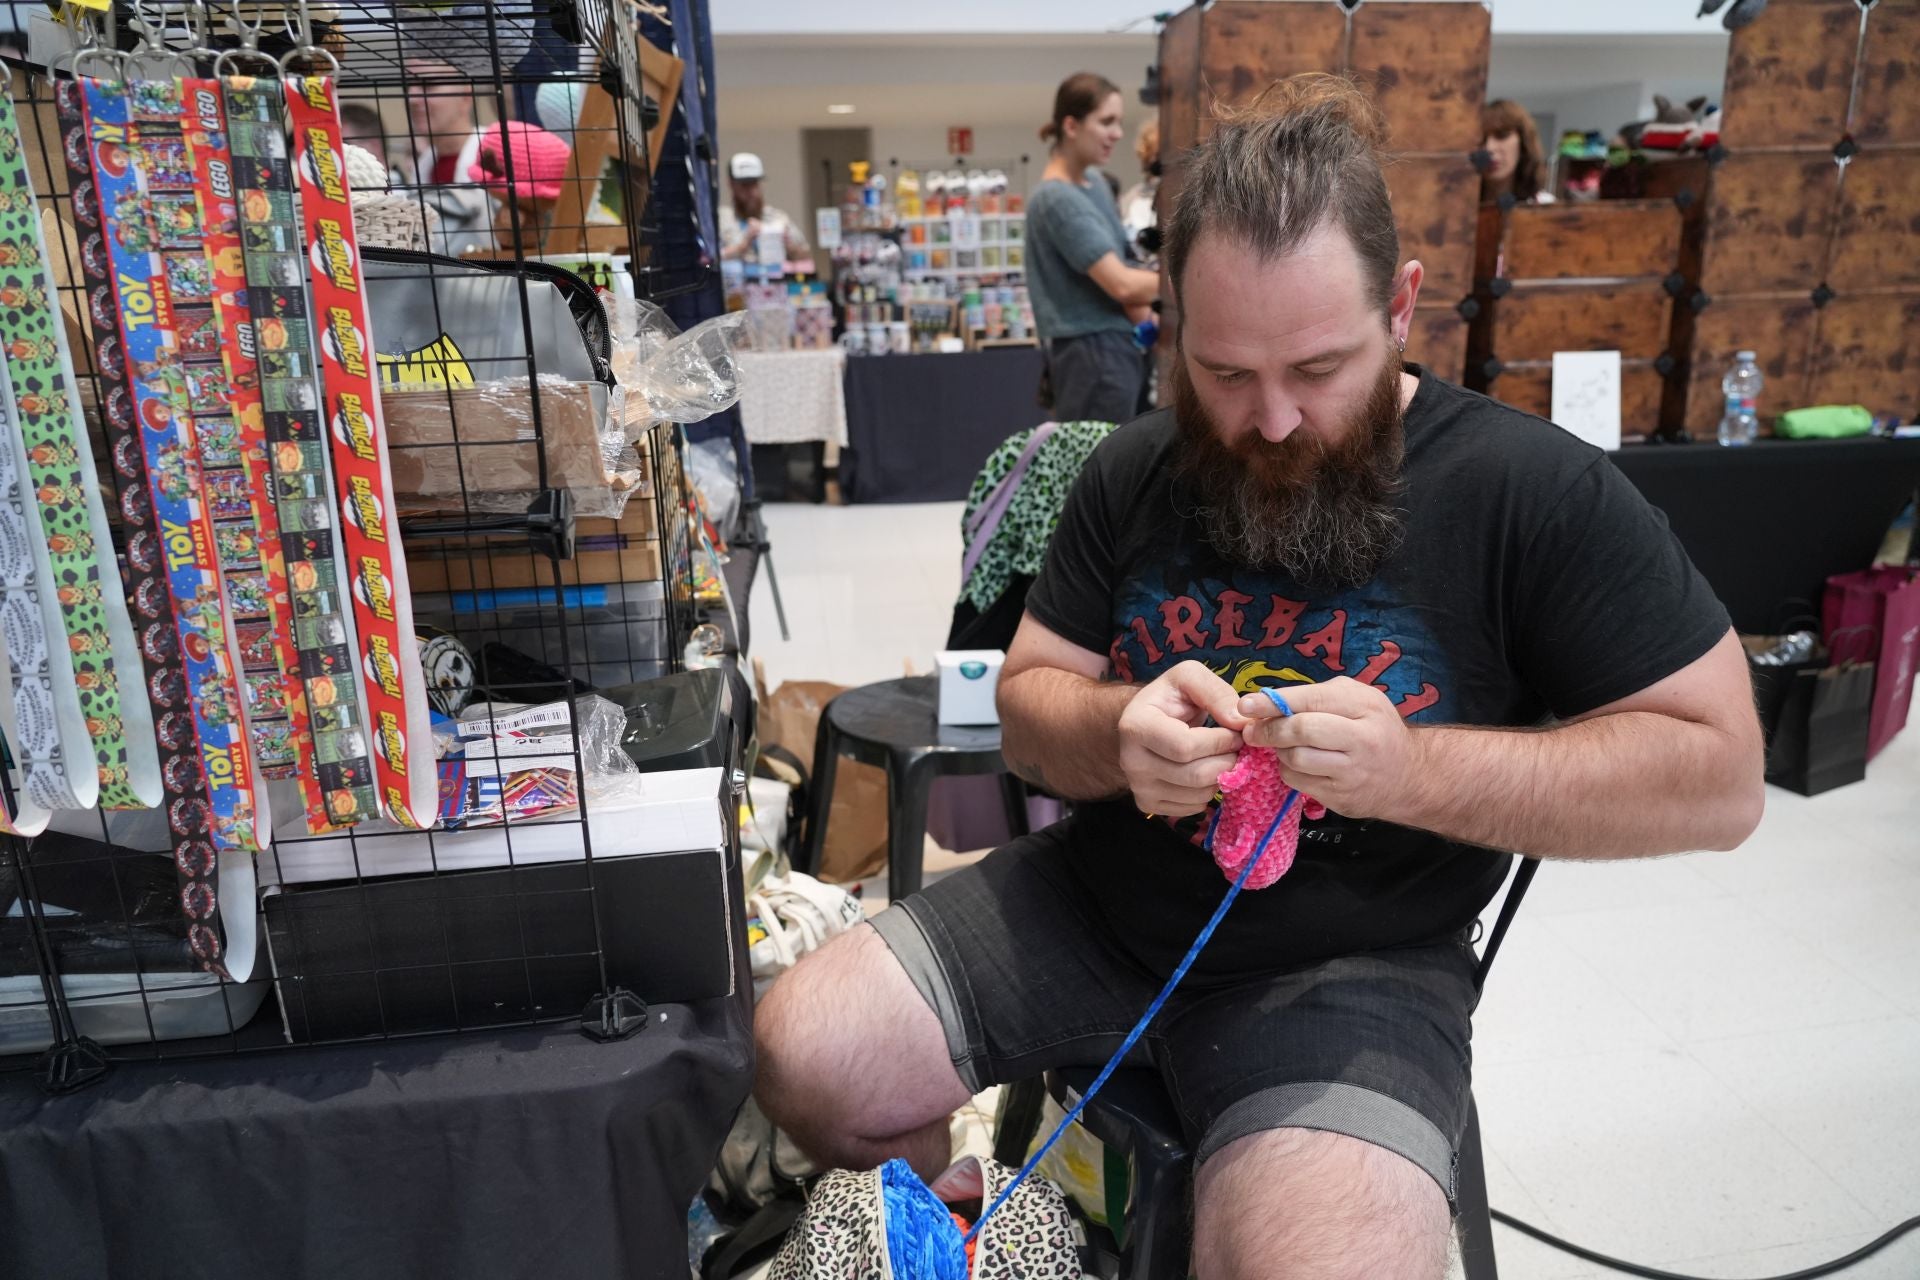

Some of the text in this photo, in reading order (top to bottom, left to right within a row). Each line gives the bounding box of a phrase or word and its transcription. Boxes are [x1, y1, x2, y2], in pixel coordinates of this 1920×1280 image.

[208, 159, 233, 198] LEGO
[308, 127, 347, 203] BAZINGA!
[319, 218, 358, 293] BAZINGA!
[118, 273, 155, 332] TOY
[152, 280, 170, 326] STORY
[235, 322, 256, 360] LEGO
[329, 306, 368, 379] BAZINGA!
[376, 333, 474, 391] TMAN
[340, 392, 377, 462] BAZINGA!
[351, 475, 386, 543] BAZINGA!
[161, 519, 195, 572] TOY
[192, 524, 208, 566] STORY
[361, 555, 394, 622] BAZINGA!
[371, 633, 402, 699] BAZINGA!
[203, 743, 234, 791] TOY
[231, 747, 245, 785] STORY
[380, 711, 406, 776] BAZINGA!
